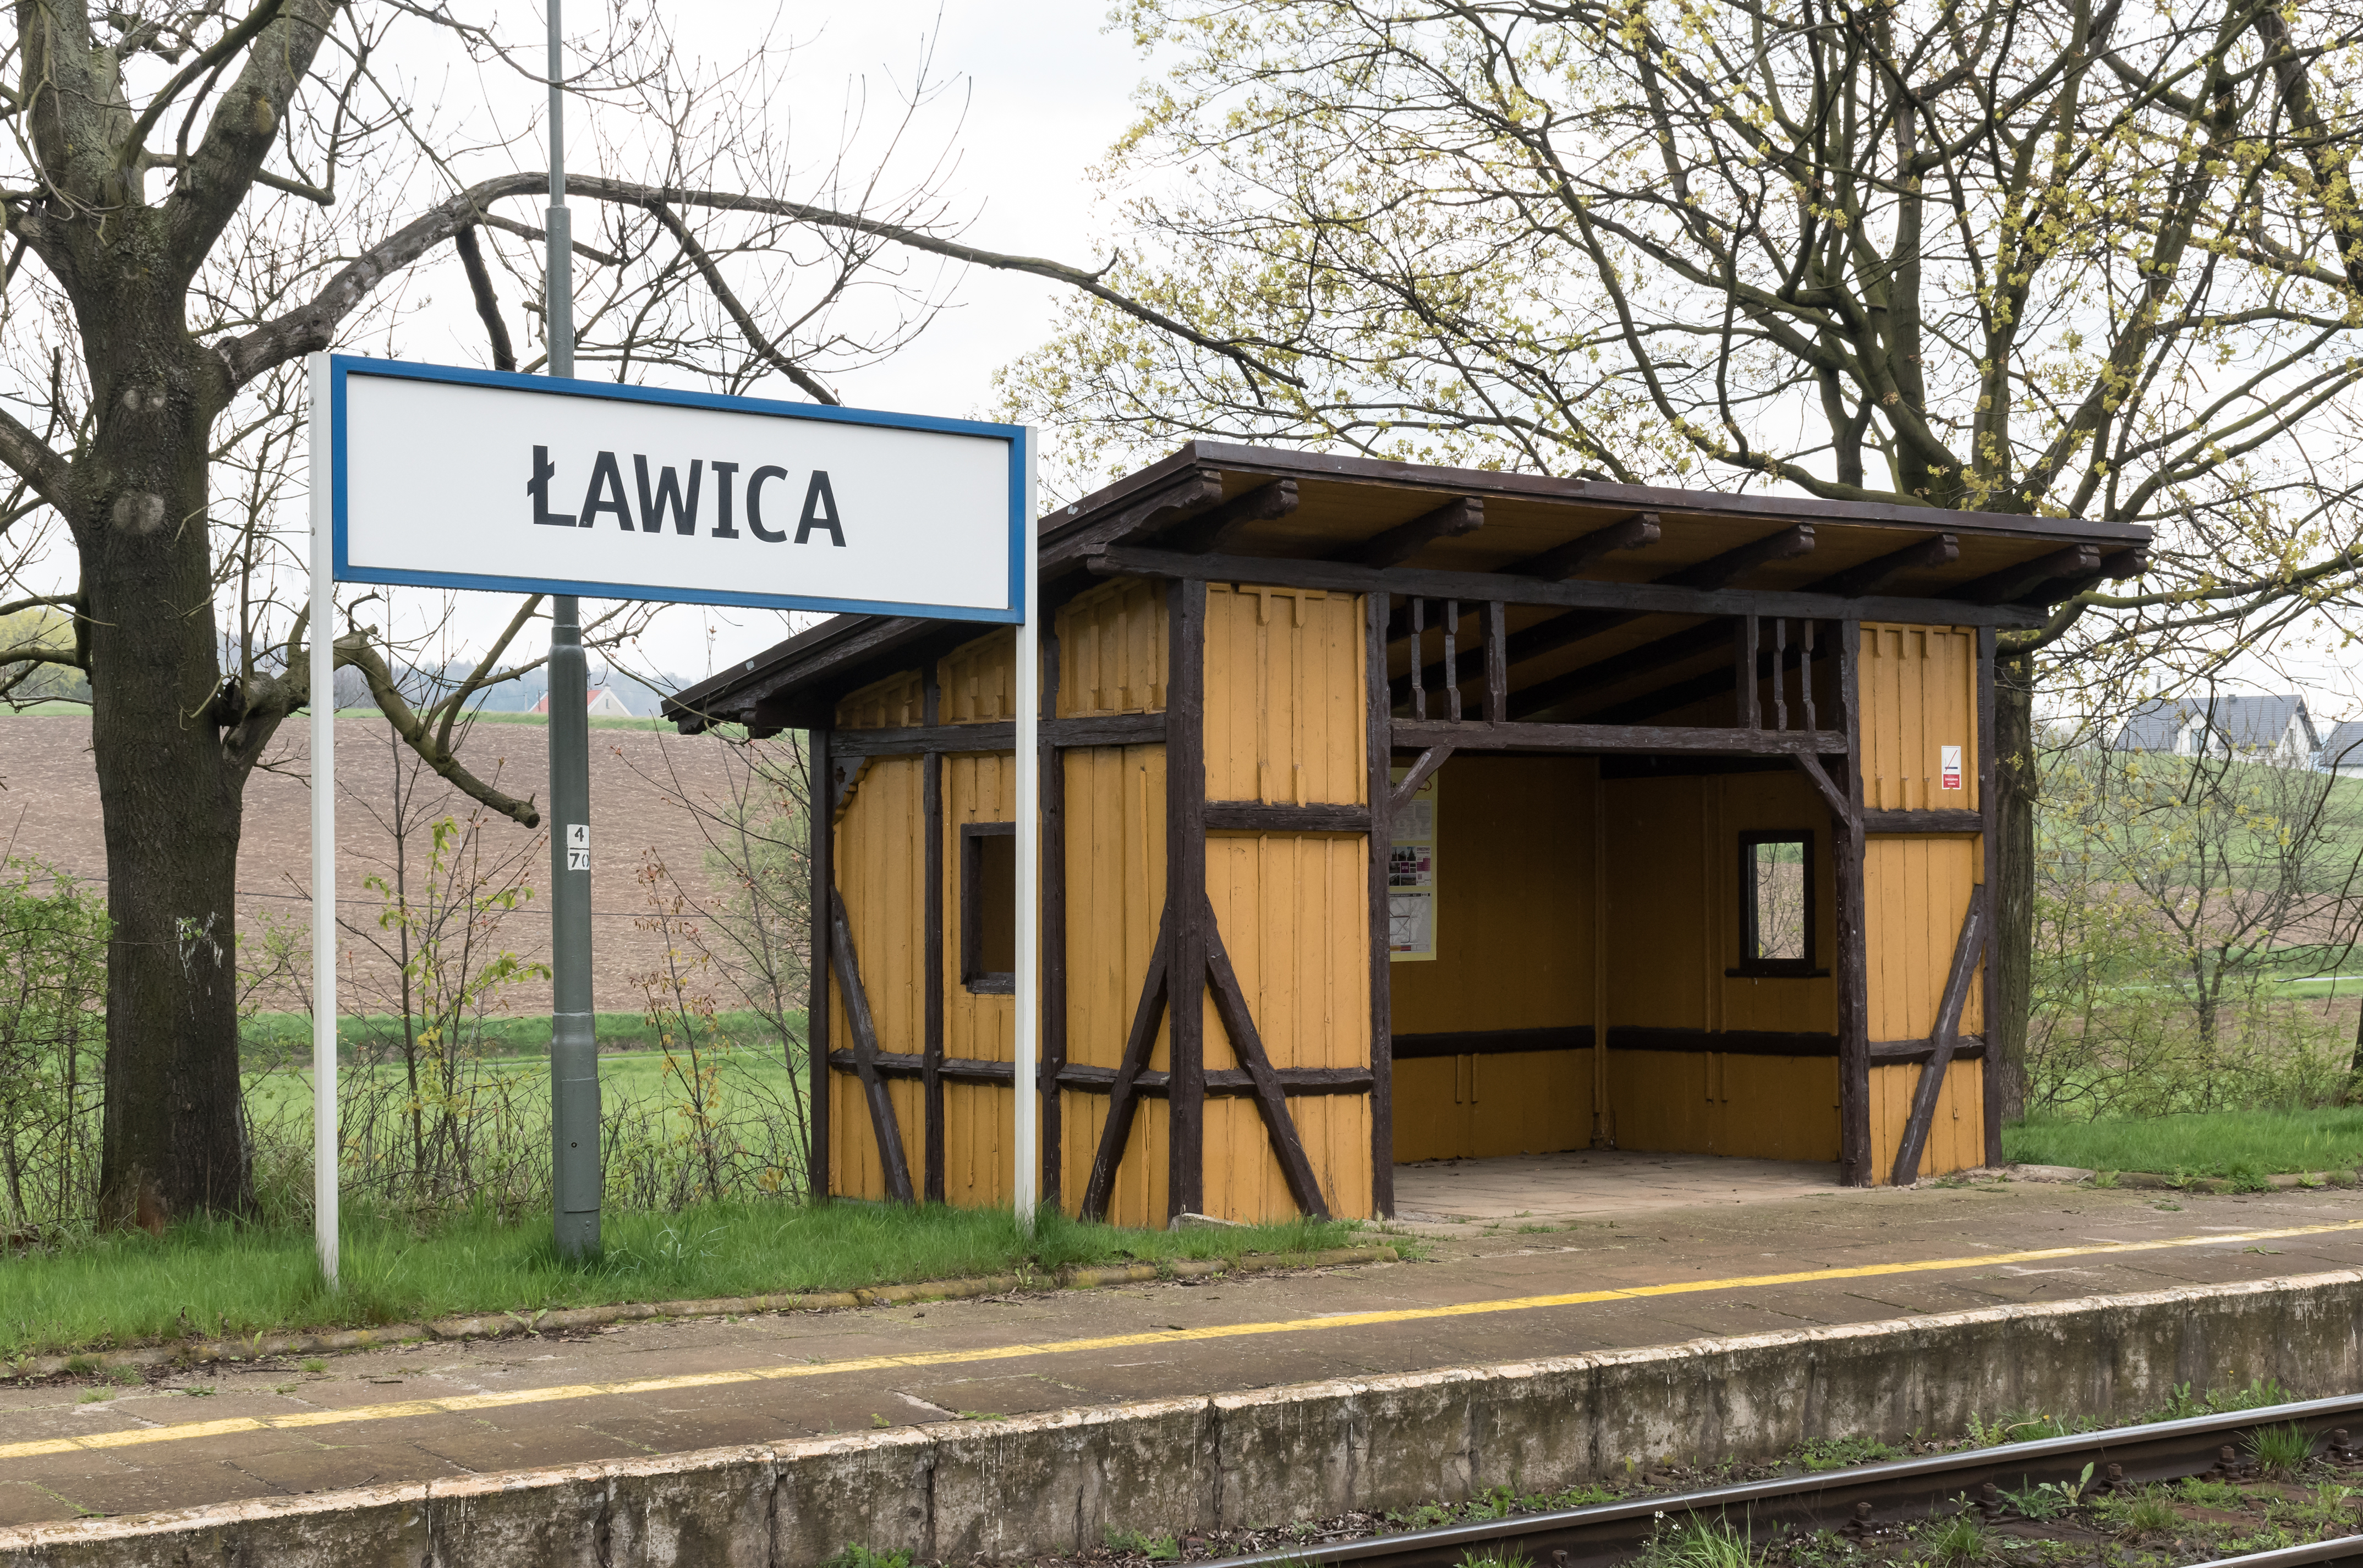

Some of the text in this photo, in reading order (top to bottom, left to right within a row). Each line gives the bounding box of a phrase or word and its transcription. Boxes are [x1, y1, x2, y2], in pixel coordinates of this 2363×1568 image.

[527, 445, 847, 547] ŁAWICA
[574, 826, 584, 842] 4
[569, 852, 590, 868] 70
